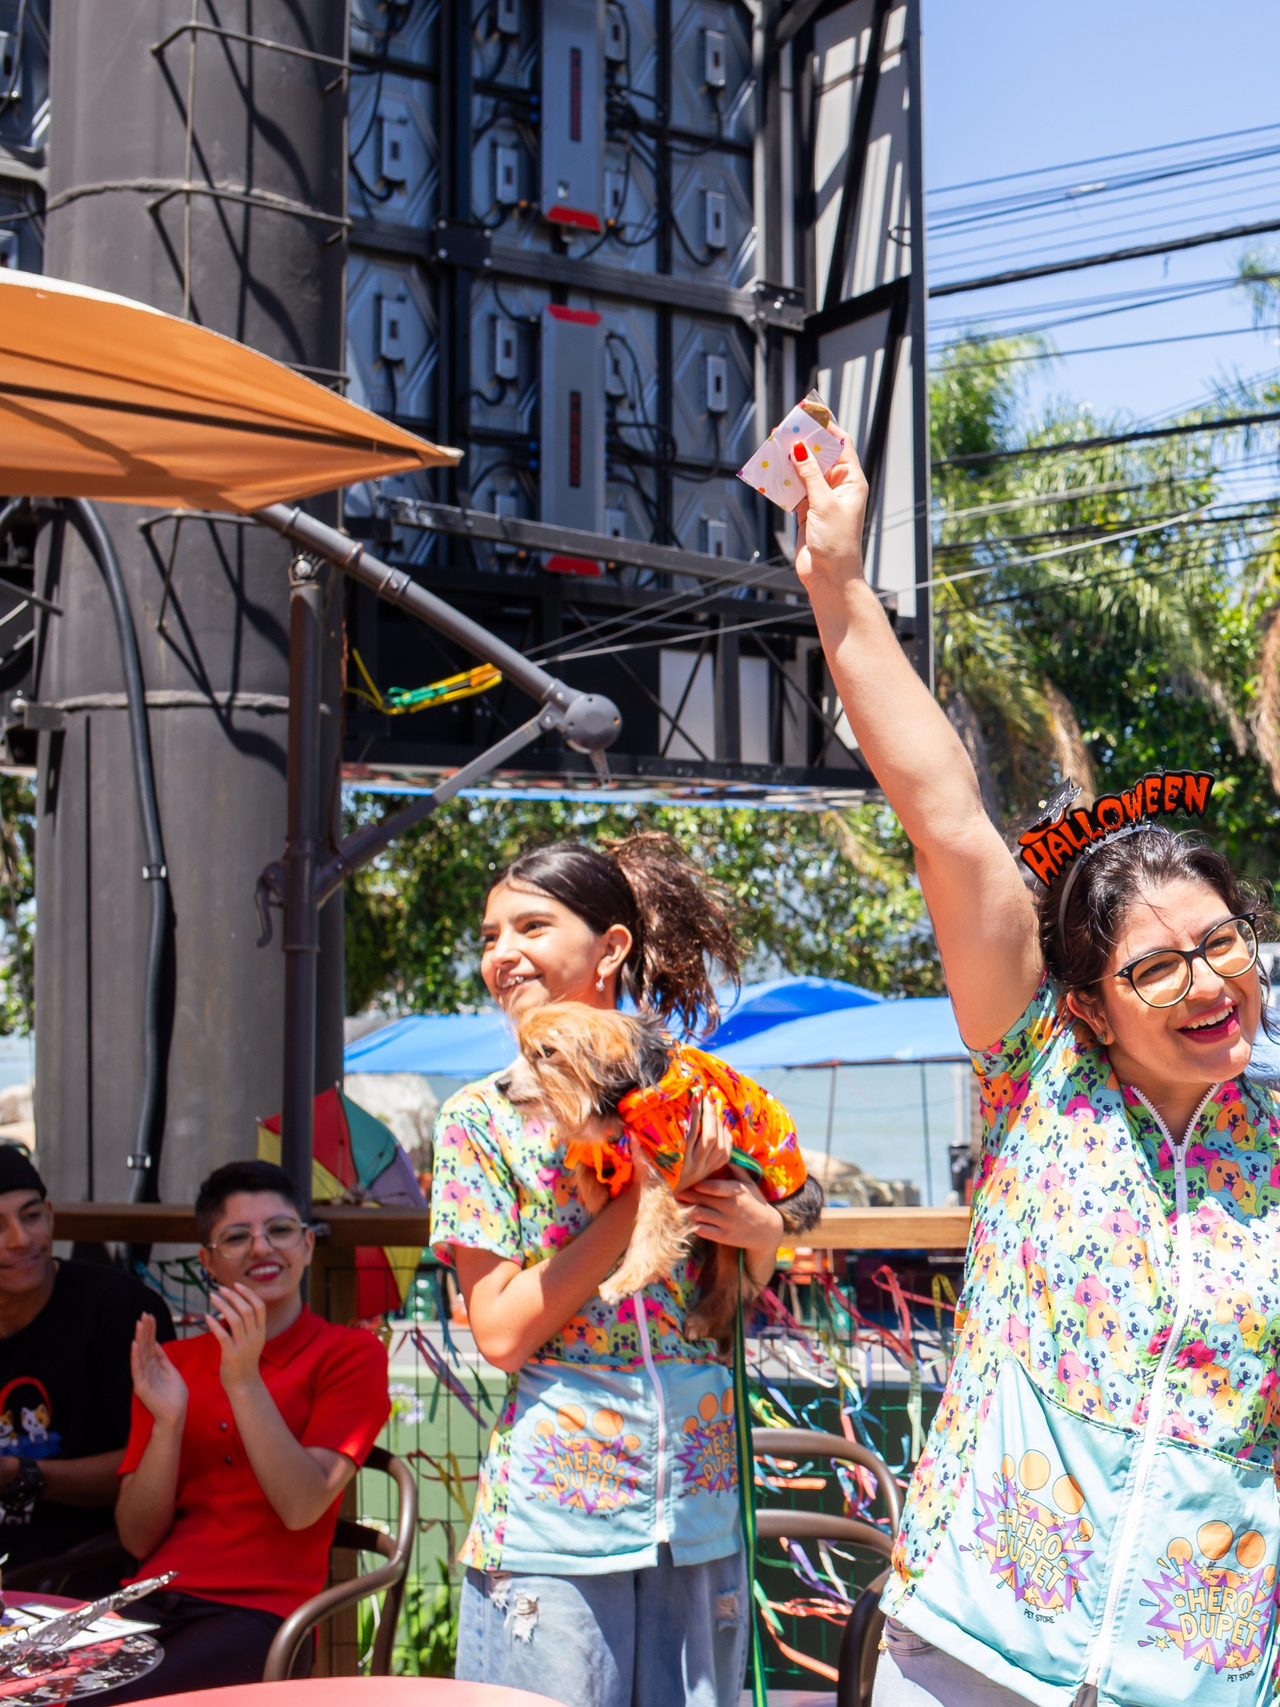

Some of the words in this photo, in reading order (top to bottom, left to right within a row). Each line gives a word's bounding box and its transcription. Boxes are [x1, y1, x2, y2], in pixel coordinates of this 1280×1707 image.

[1021, 773, 1212, 887] HALLOWEEN
[556, 1451, 617, 1473] HERO
[702, 1451, 738, 1482] DUPE
[553, 1470, 625, 1493] DUPET
[1005, 1507, 1063, 1561] HERO
[995, 1530, 1065, 1592] DUPET
[1023, 1608, 1034, 1619] PET
[1035, 1614, 1055, 1624] STORE
[1187, 1585, 1254, 1618] HERO
[1178, 1612, 1259, 1648] DUPET
[1227, 1674, 1238, 1682] PET
[1238, 1669, 1256, 1681] STORE
